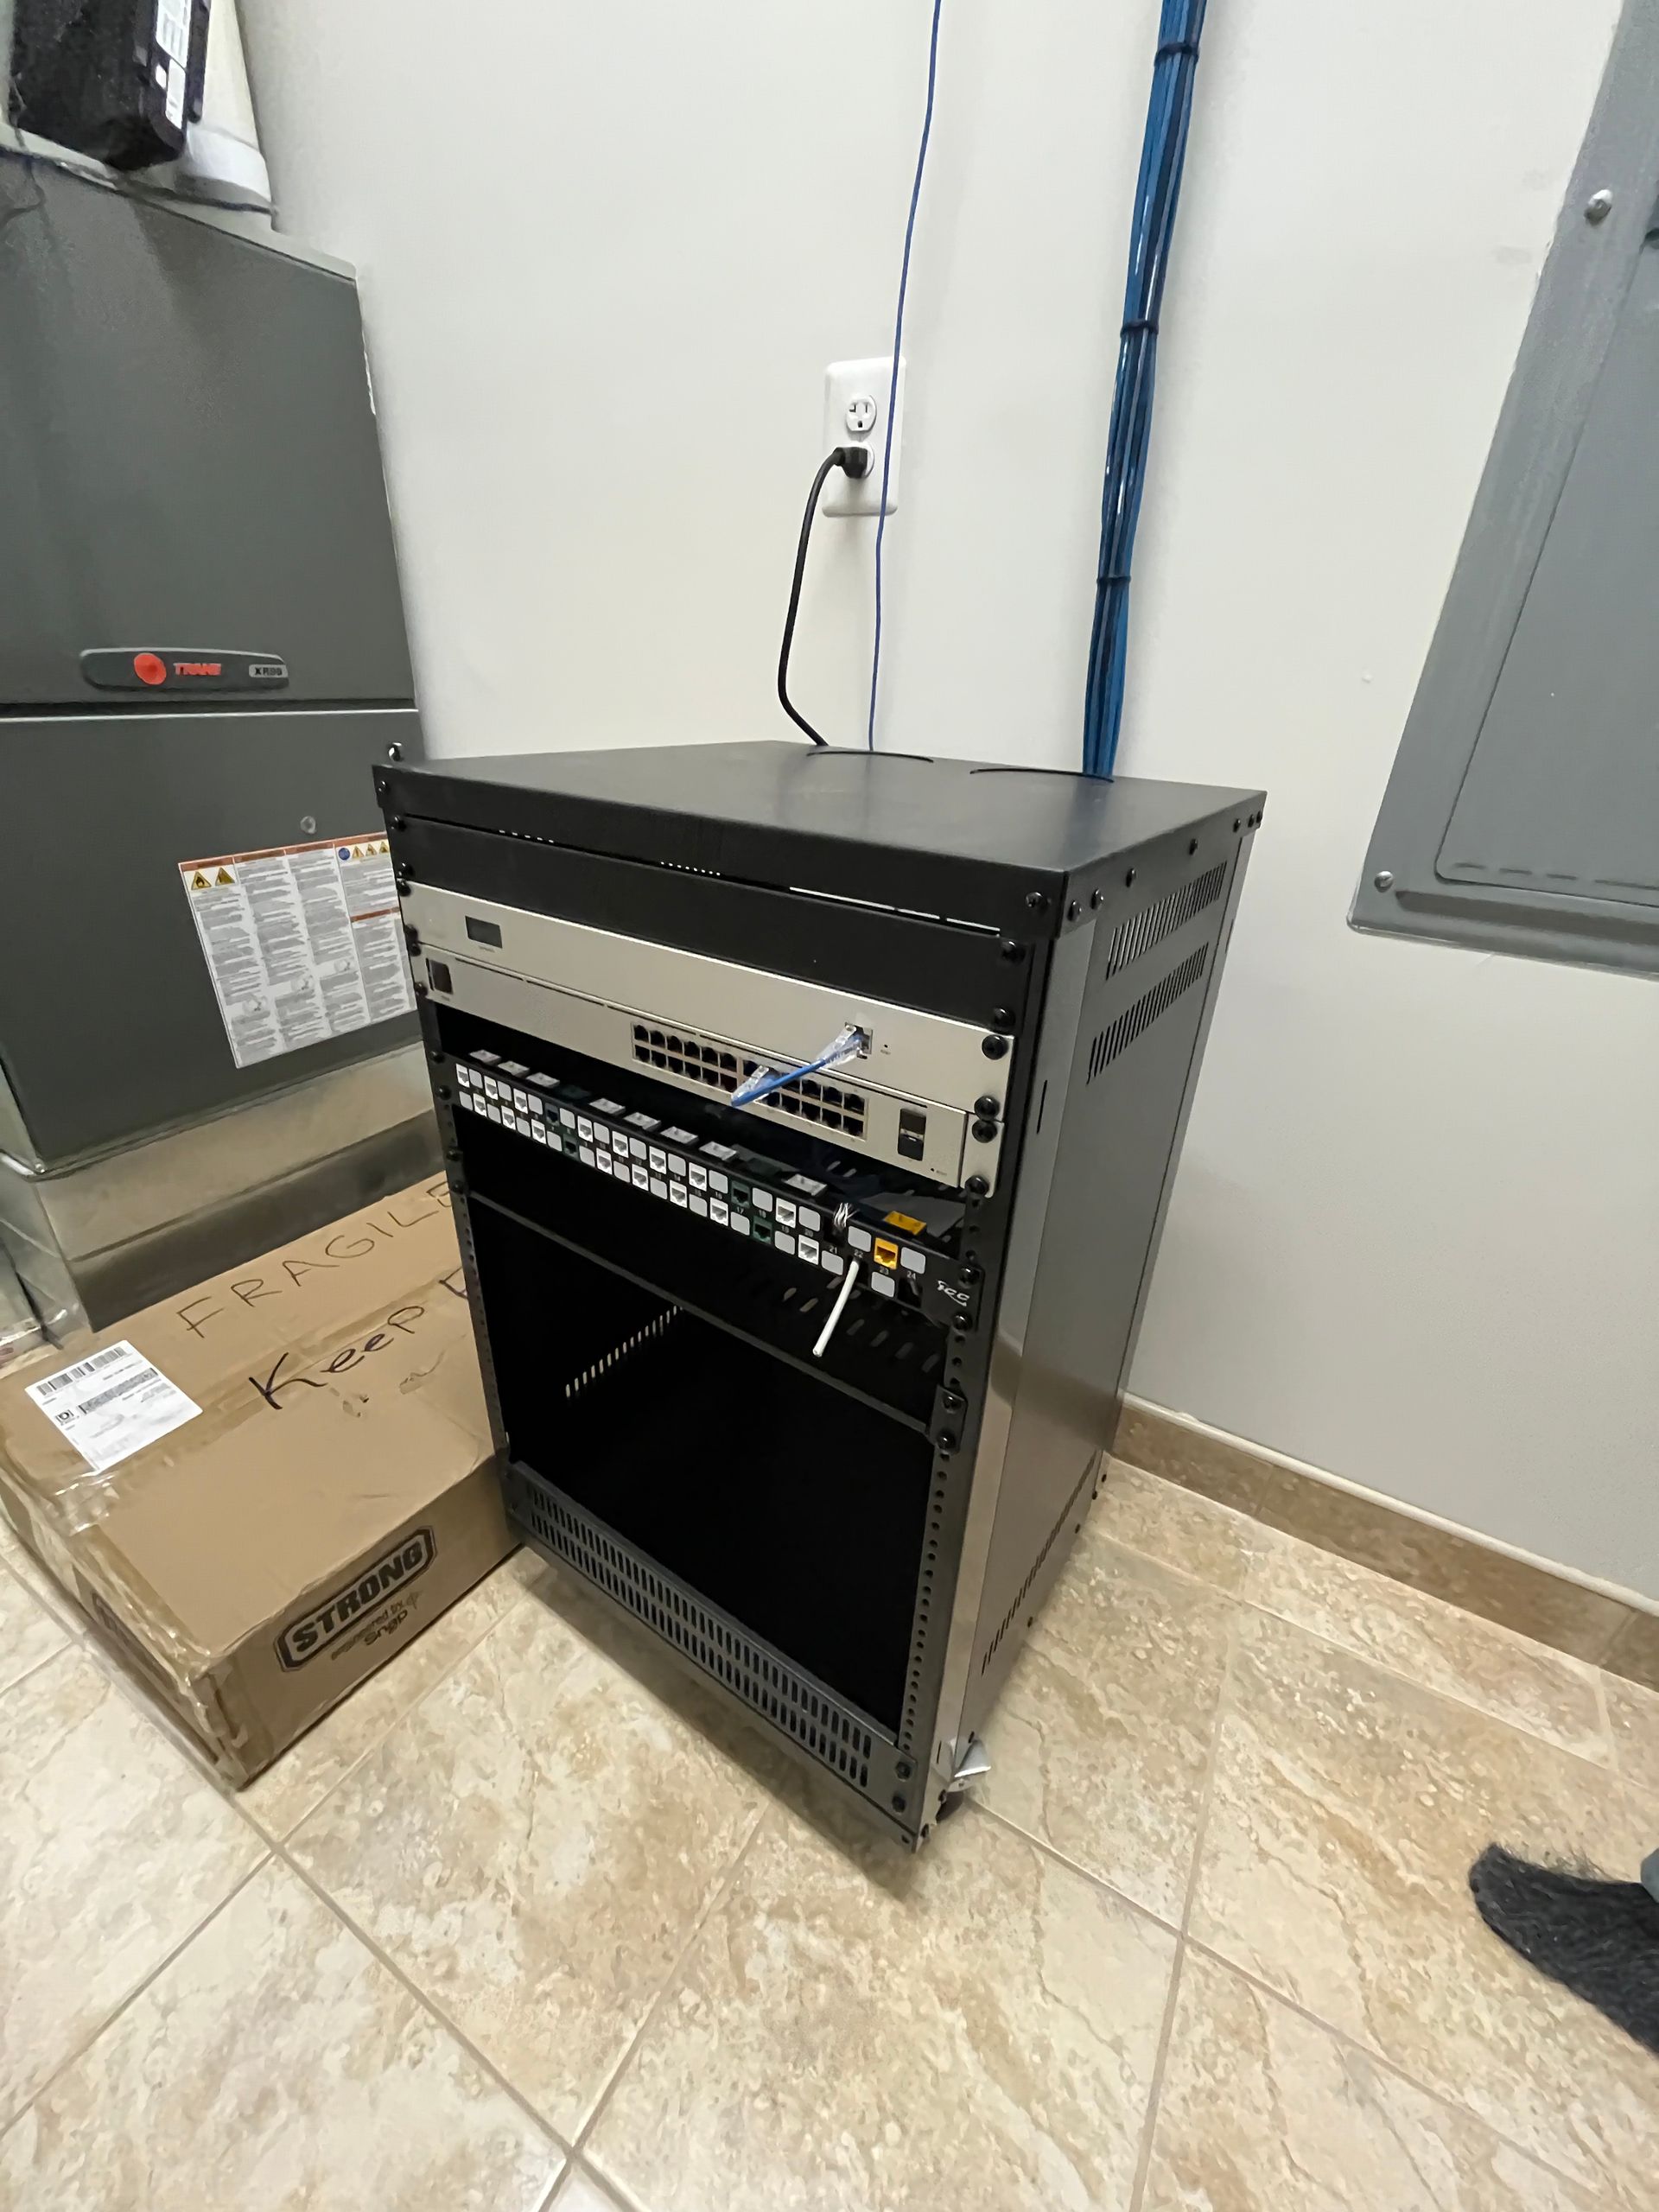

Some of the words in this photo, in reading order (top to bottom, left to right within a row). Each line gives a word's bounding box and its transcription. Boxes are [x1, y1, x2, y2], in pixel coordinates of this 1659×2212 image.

[176, 1180, 453, 1339] FRAGILE
[829, 1245, 838, 1254] 21
[854, 1249, 863, 1259] 22
[906, 1270, 917, 1281] 24
[291, 1540, 424, 1654] STRONG
